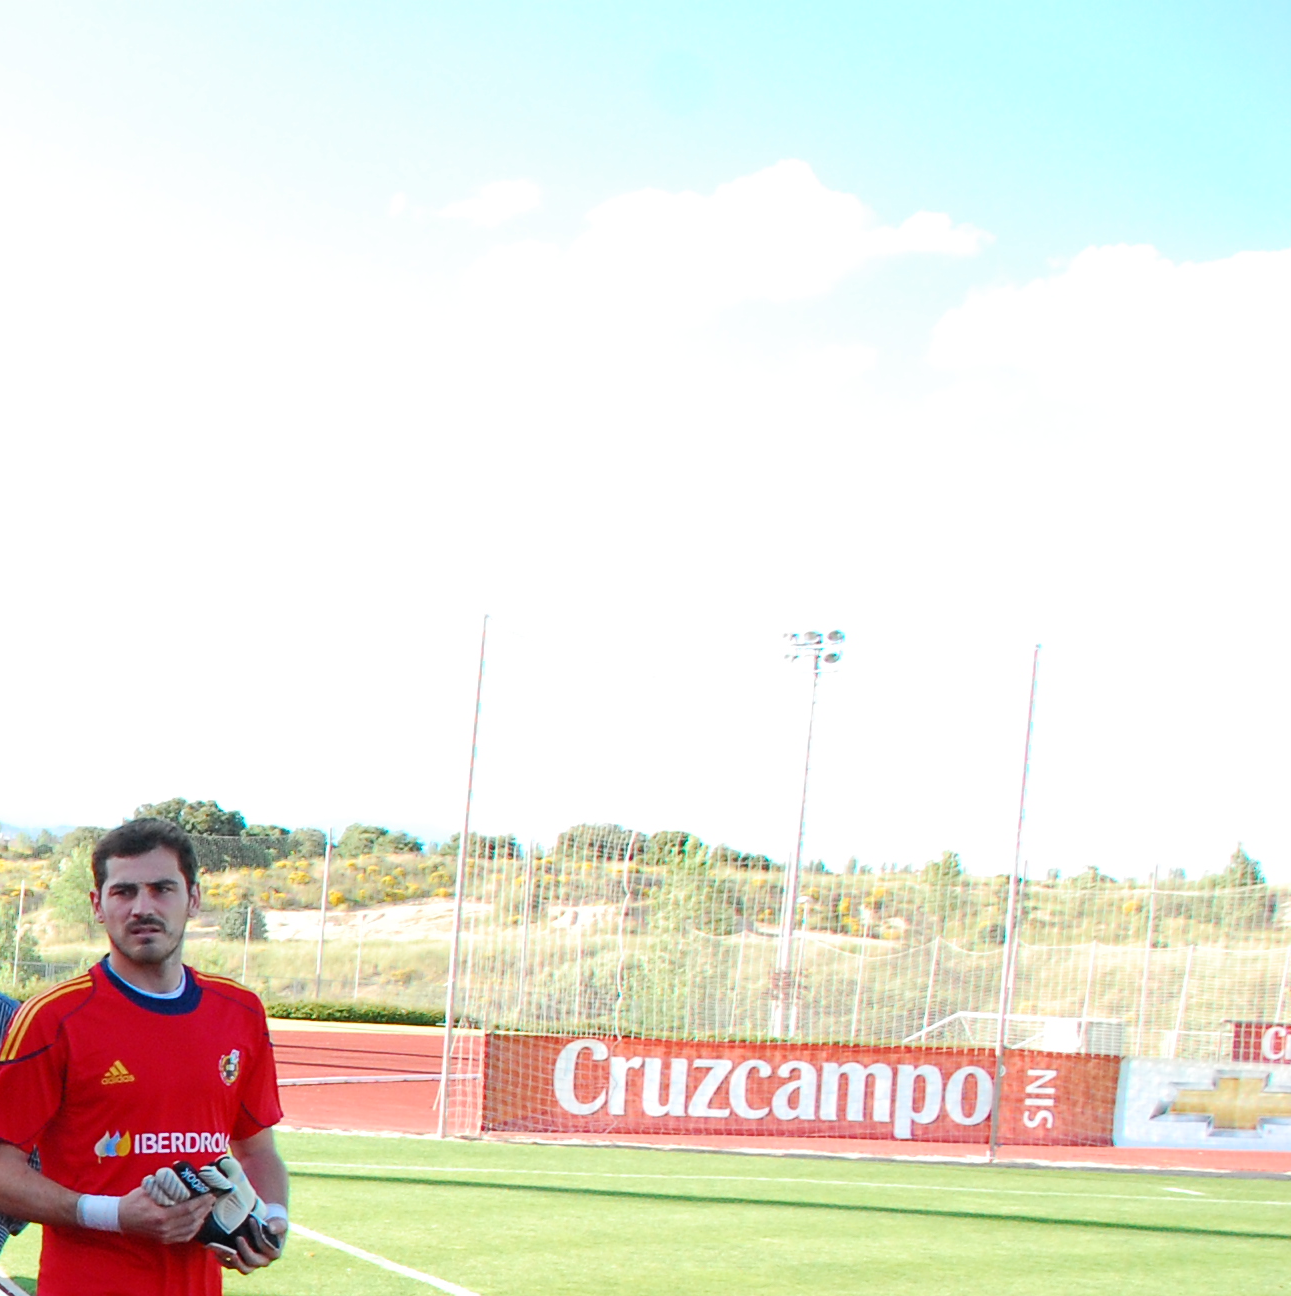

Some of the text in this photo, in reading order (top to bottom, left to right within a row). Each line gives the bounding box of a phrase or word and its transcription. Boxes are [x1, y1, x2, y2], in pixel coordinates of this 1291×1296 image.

[101, 1074, 135, 1085] adidas
[553, 1038, 995, 1140] Cruzcampo
[1023, 1068, 1058, 1129] SIN
